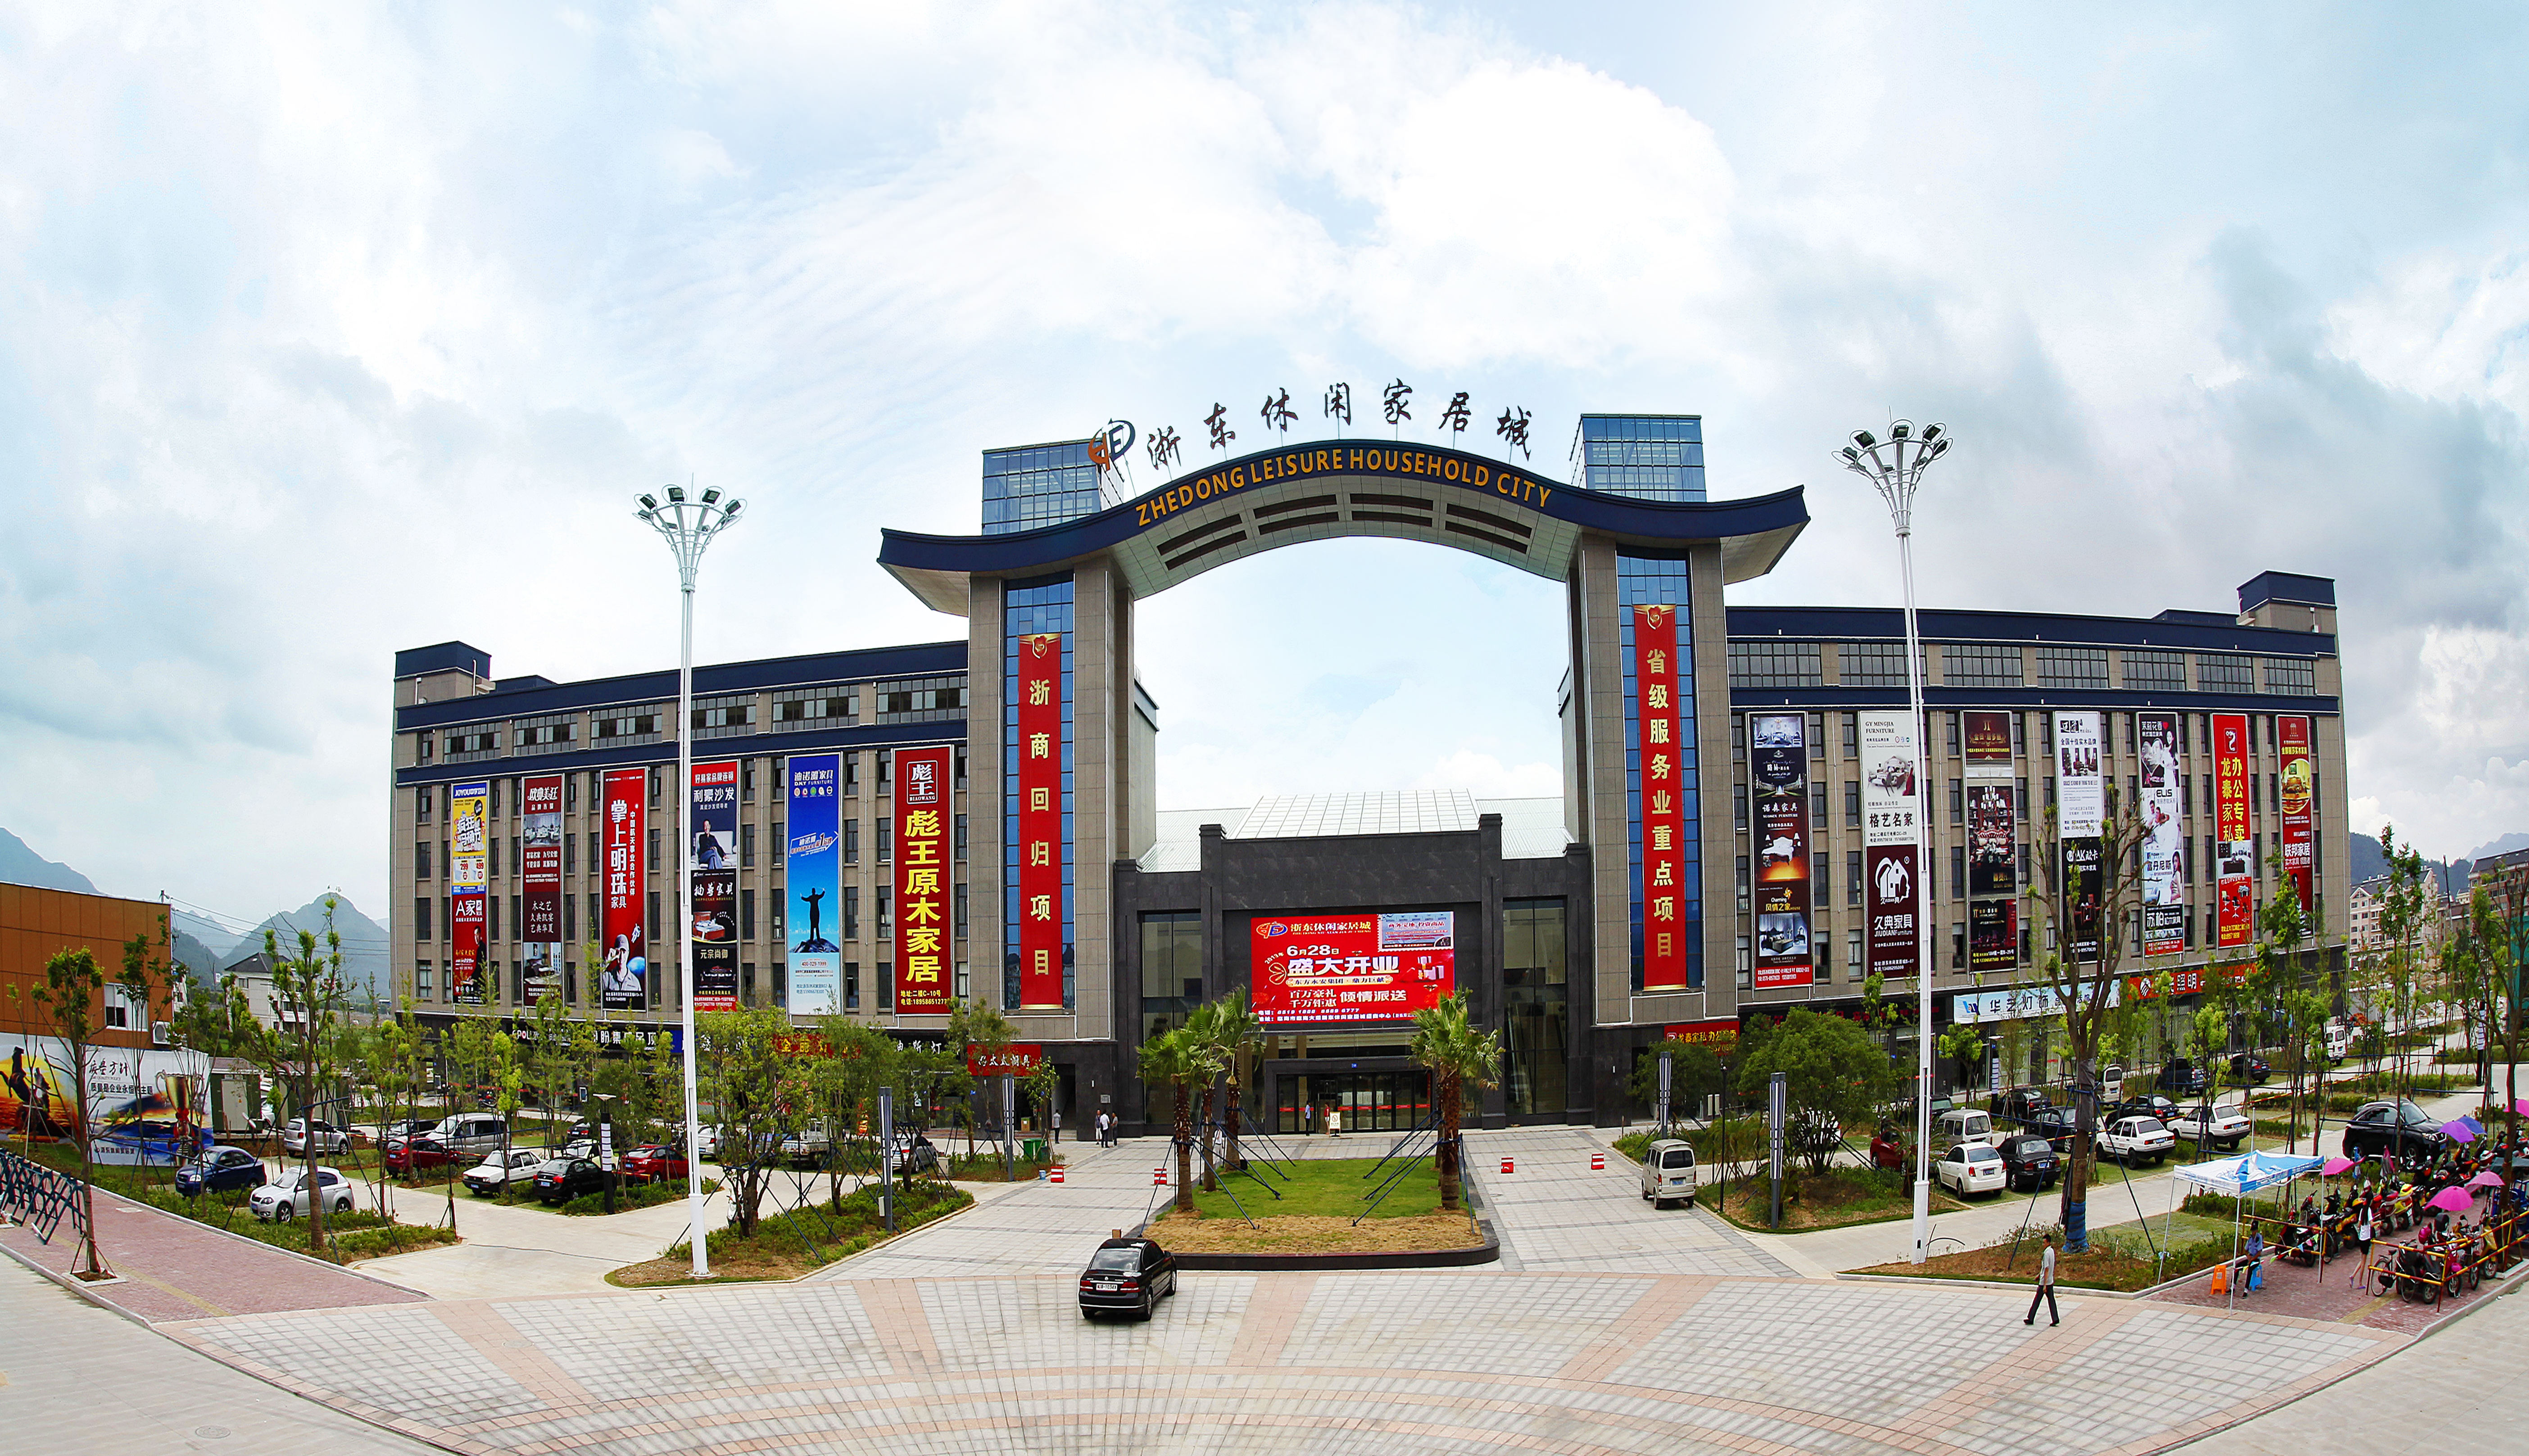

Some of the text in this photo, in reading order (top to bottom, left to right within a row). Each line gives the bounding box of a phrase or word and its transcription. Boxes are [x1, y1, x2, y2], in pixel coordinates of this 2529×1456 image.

[1147, 378, 1532, 470] 浙东休闲家居城
[1136, 449, 1552, 527] ZHEDONG LEISURE HOUSEHOLD CITY
[912, 763, 933, 796] 彪王
[693, 787, 734, 803] 利豪沙发
[1647, 649, 1674, 958] 省级服务业重点项目
[2221, 757, 2234, 844] 龙泰家私
[2232, 757, 2245, 843] 办公专卖
[1029, 679, 1050, 975] 浙商回归项目
[1869, 812, 1913, 827] 格艺名家
[611, 799, 627, 895] 掌上明珠
[611, 896, 627, 909] 家具
[904, 809, 941, 983] 彪王原木家居
[1765, 903, 1790, 912] 风情之家
[1291, 922, 1371, 931] 浙东休闲家居城
[1874, 914, 1913, 931] 久典家具
[1287, 945, 1339, 956] 6月28日
[1287, 956, 1399, 976] 盛大开业
[1340, 990, 1406, 1003] 倾情派送
